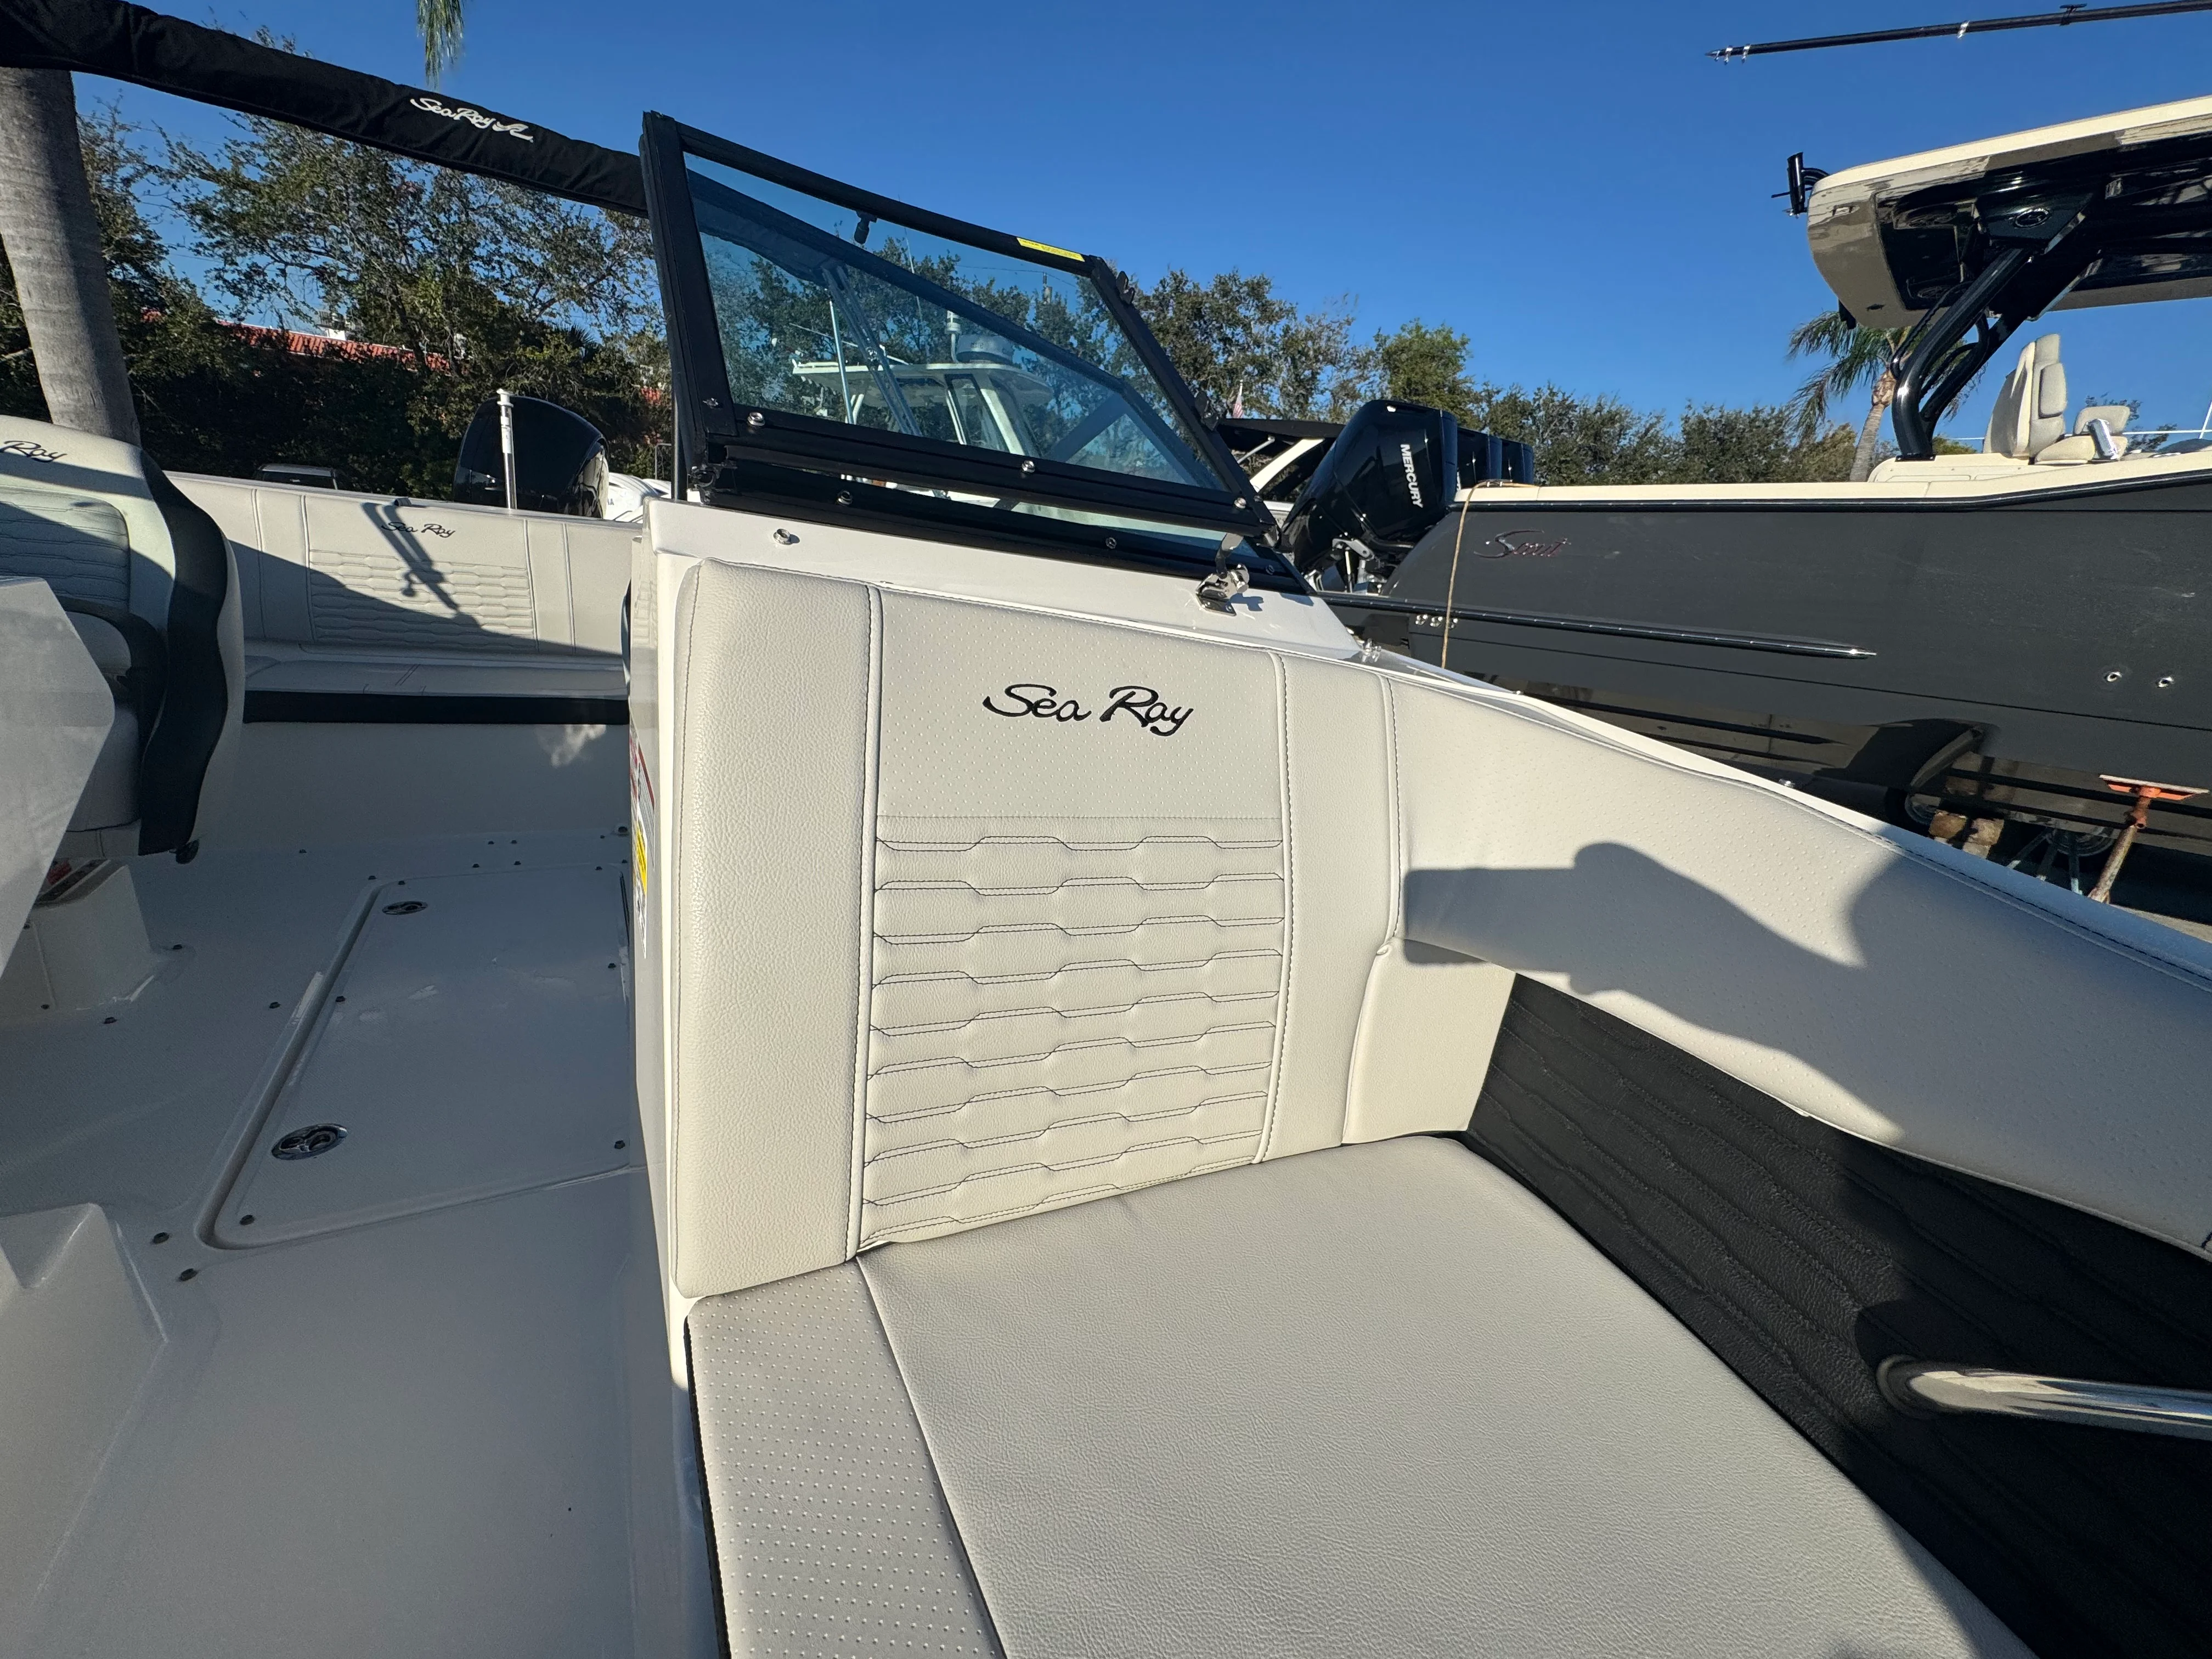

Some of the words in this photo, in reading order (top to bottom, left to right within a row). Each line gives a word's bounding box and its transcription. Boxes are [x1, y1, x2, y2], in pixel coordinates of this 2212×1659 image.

[410, 98, 455, 119] Sea
[454, 108, 496, 129] Ray
[0, 441, 68, 462] Ray
[1400, 444, 1423, 508] MERCURY
[381, 522, 418, 532] Sea
[421, 523, 455, 538] Ray
[983, 684, 1092, 722] Sea
[1099, 686, 1194, 736] Ray
